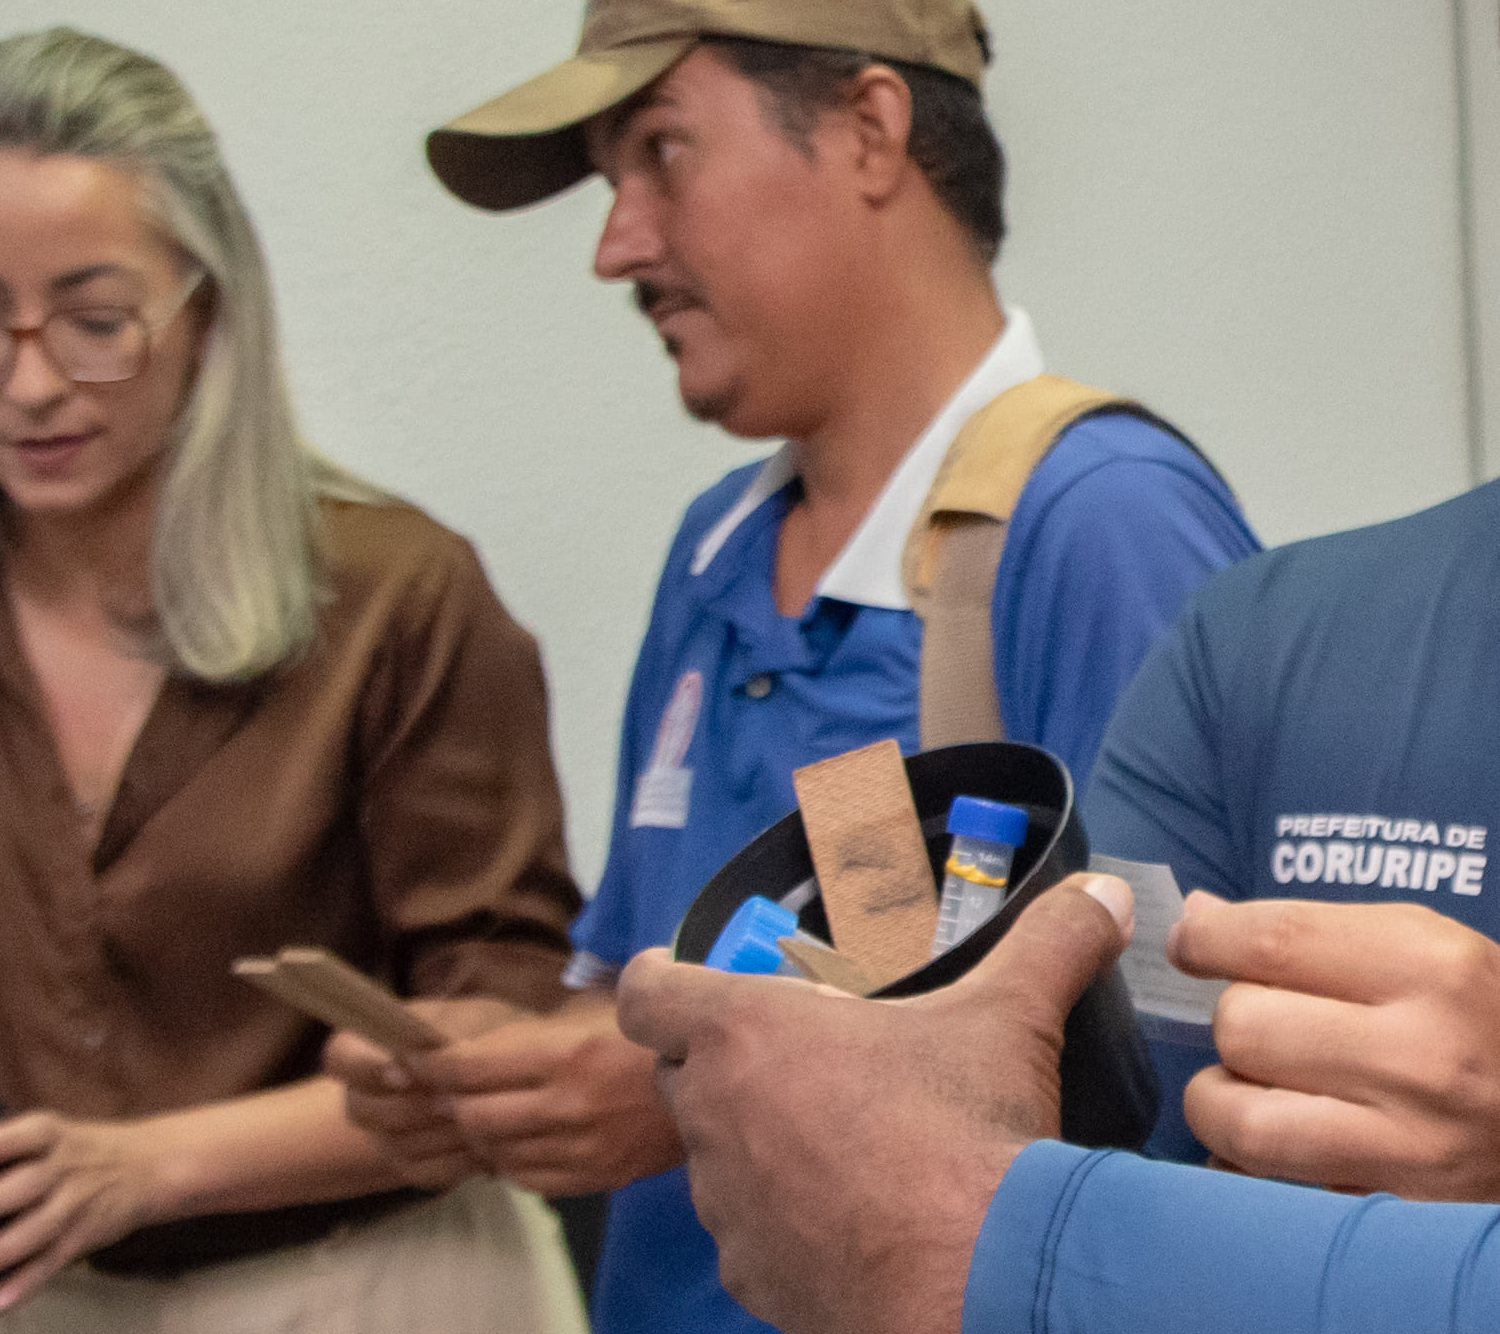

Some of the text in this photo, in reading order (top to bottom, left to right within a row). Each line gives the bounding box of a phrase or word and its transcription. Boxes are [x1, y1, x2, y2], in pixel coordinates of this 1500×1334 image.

[1277, 815, 1487, 849] PREFEITURA DE
[1272, 841, 1487, 896] CORURIPE
